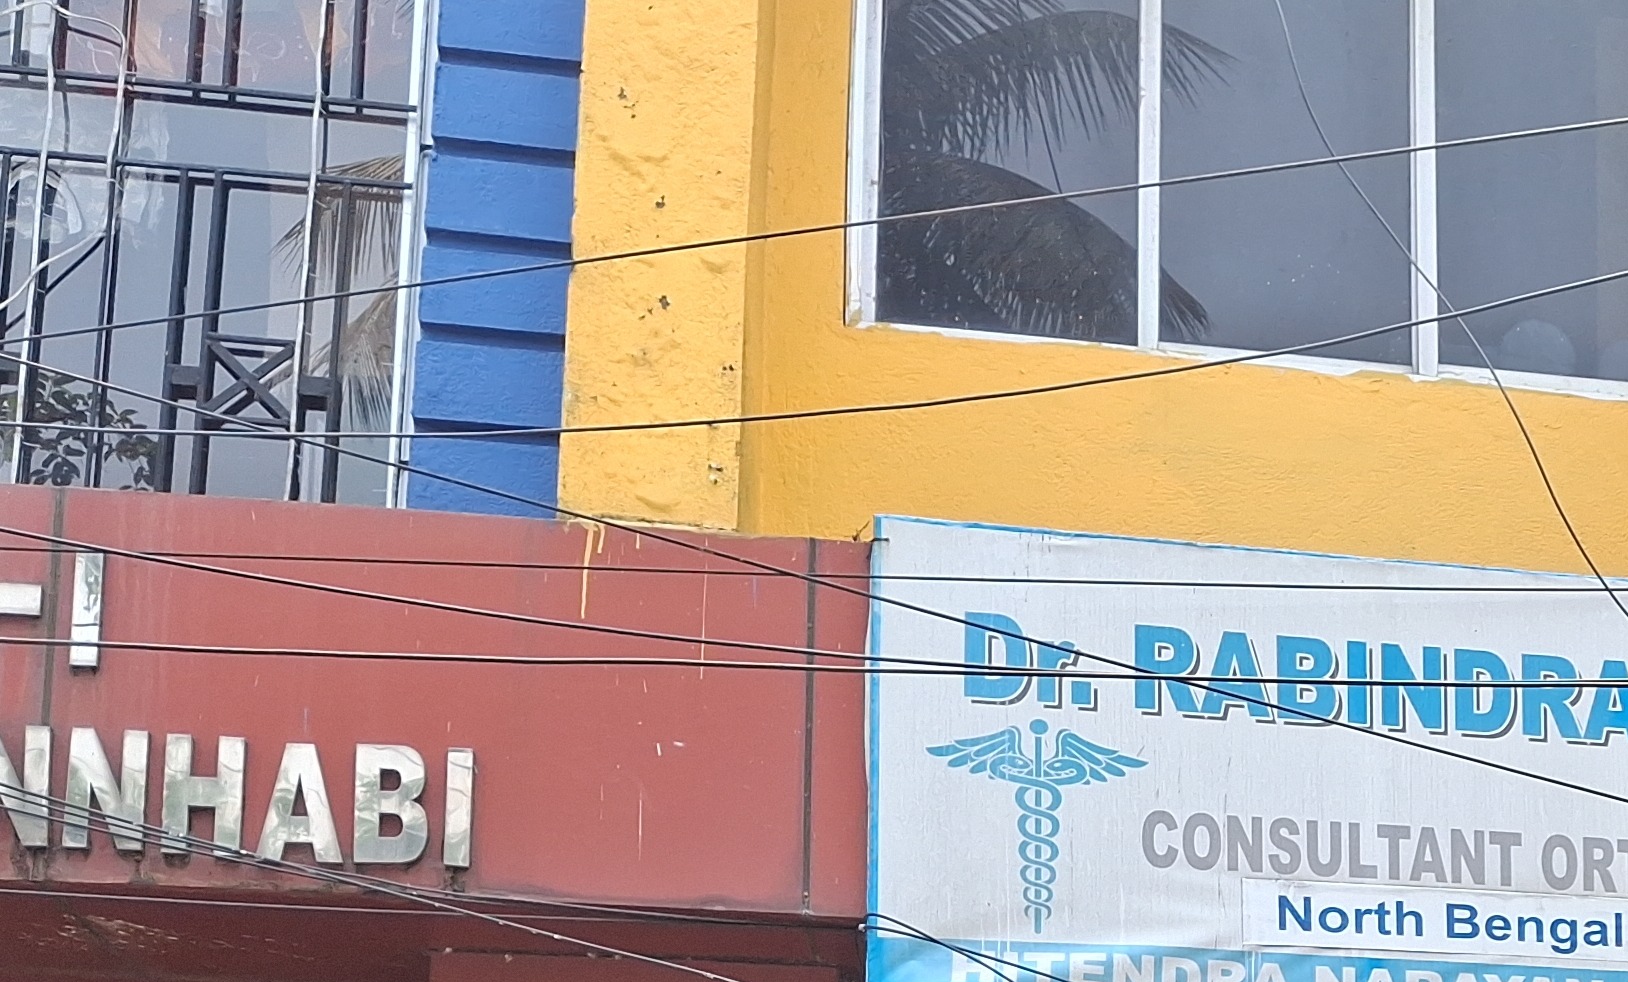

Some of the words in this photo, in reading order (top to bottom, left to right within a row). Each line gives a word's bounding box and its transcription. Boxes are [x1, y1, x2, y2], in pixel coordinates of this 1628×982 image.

[963, 610, 1099, 709] Dr.
[1142, 809, 1523, 888] CONSULTANT
[1278, 895, 1424, 939] North
[1446, 904, 1624, 955] Bengal
